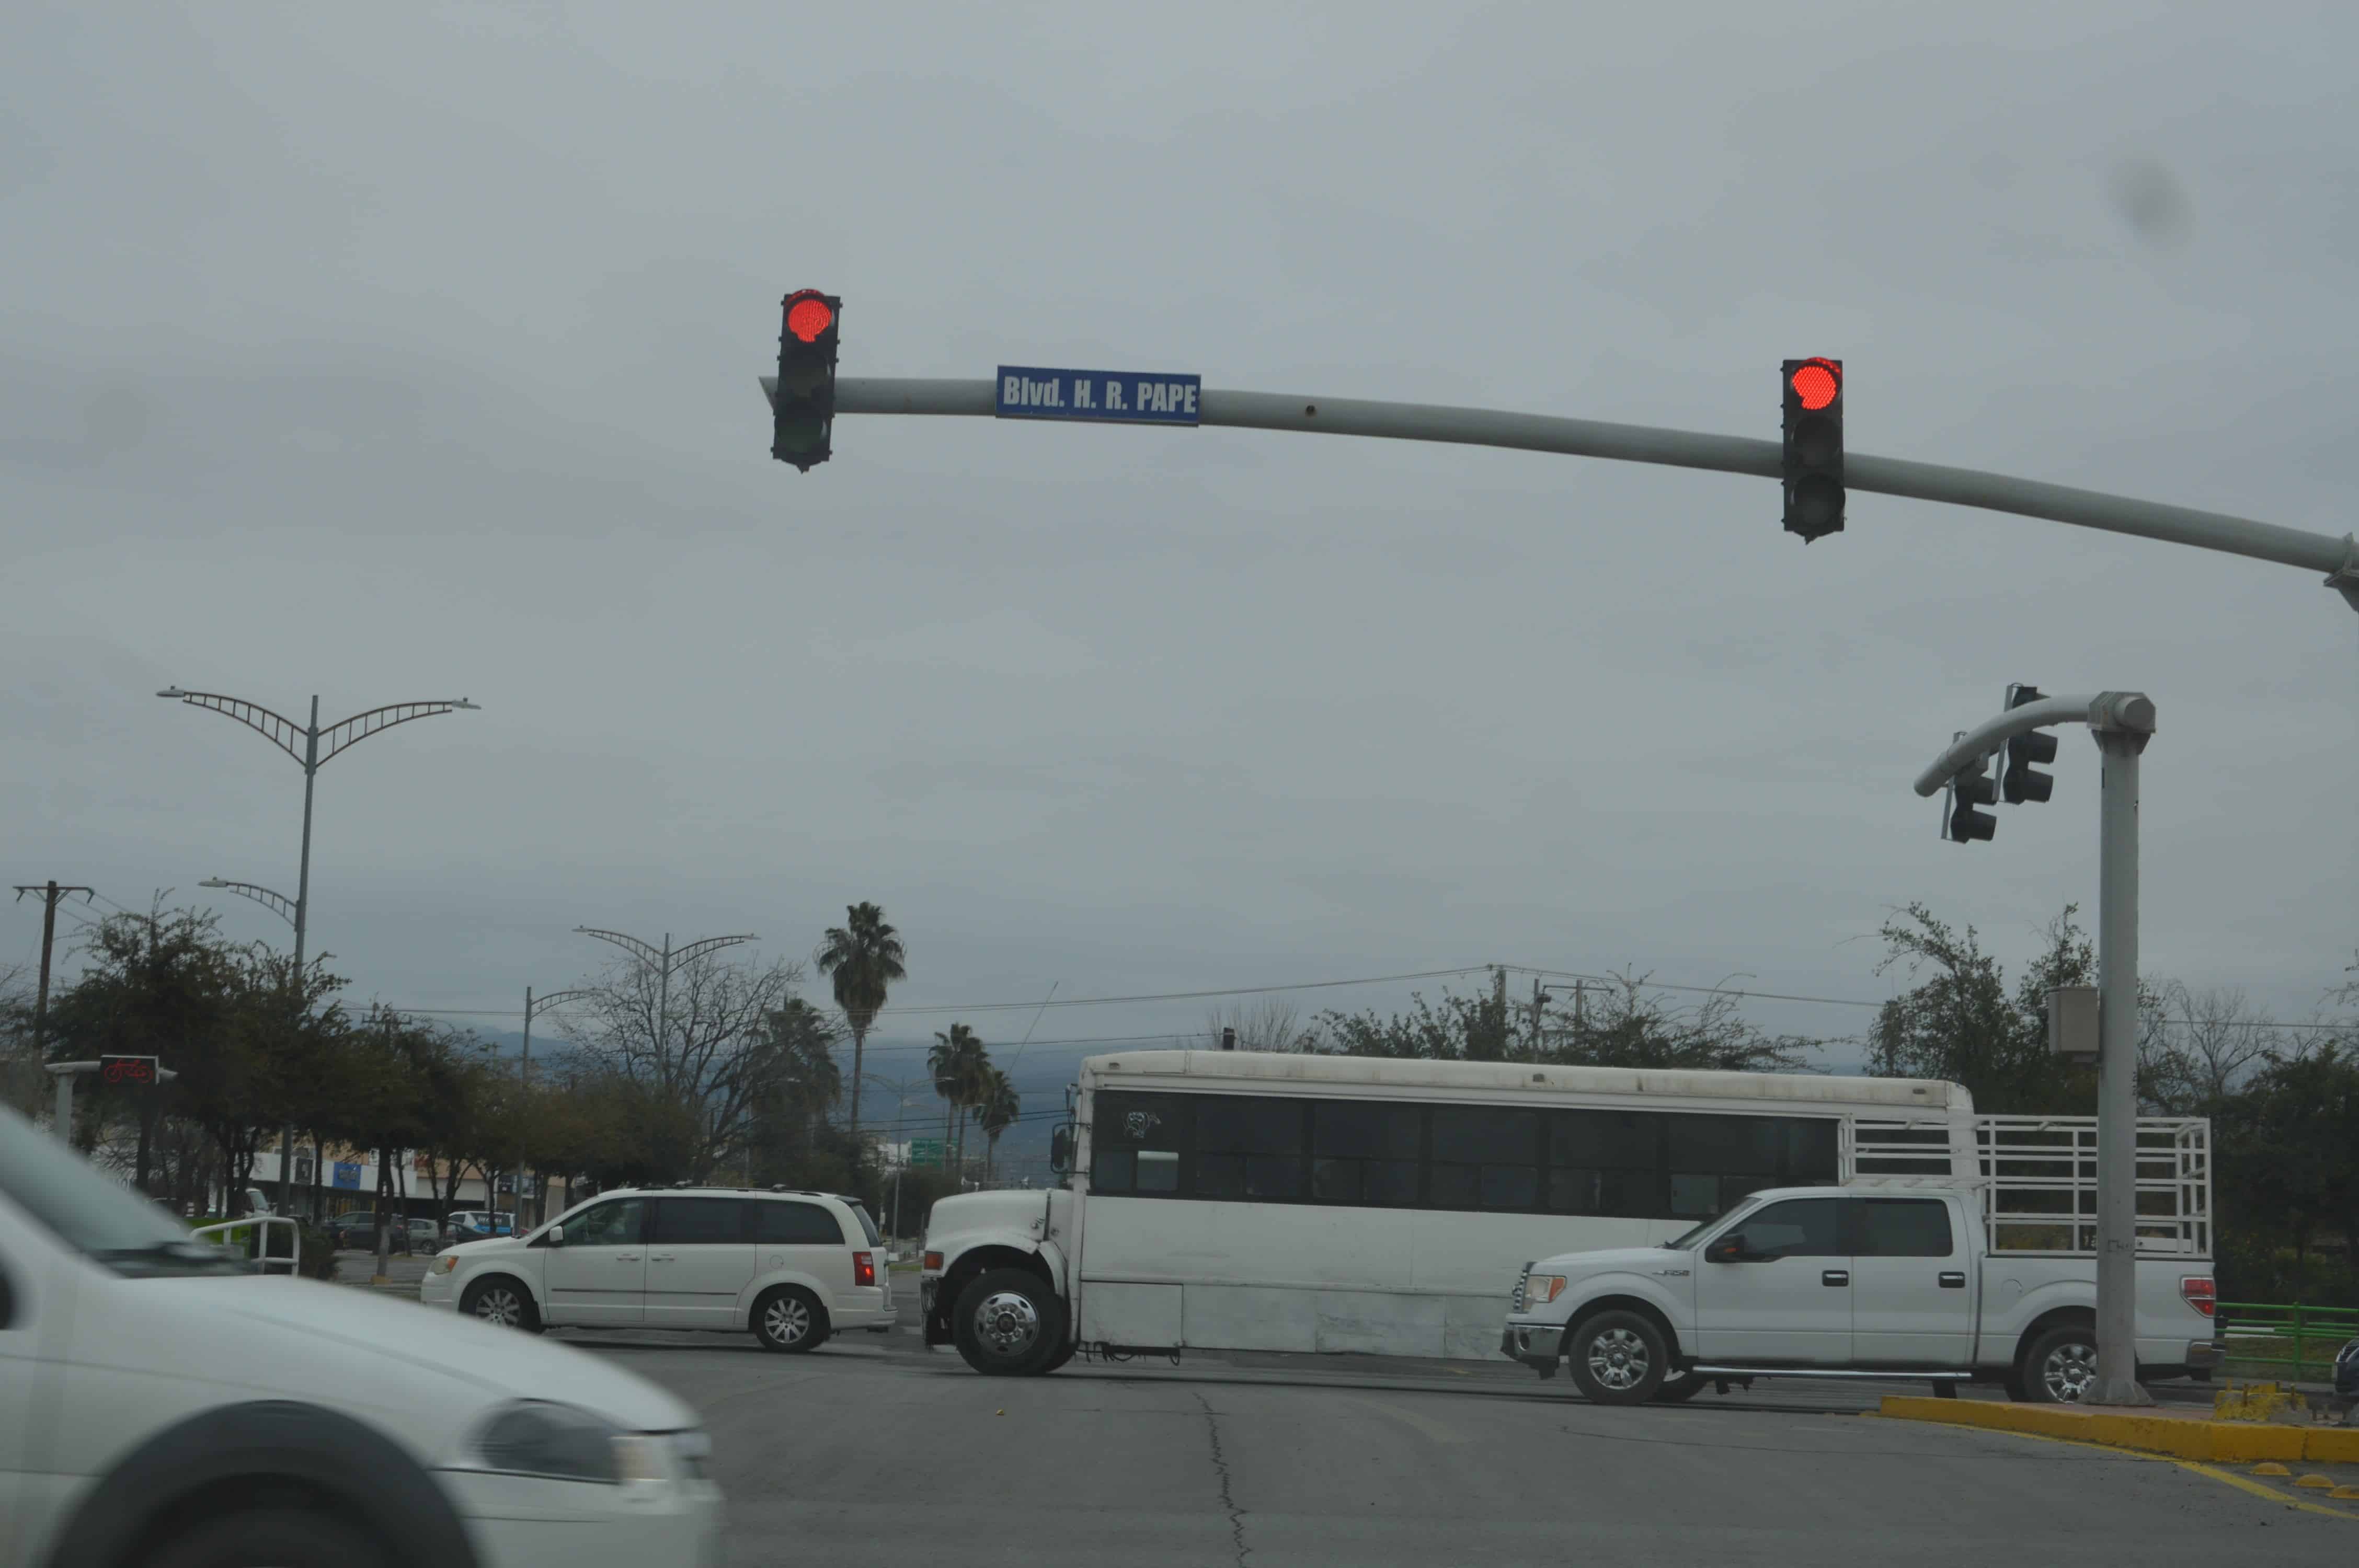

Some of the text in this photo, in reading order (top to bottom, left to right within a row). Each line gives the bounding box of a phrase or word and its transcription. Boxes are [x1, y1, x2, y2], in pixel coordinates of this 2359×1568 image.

[1003, 376, 1197, 413] Blvd. H. R. PAPE
